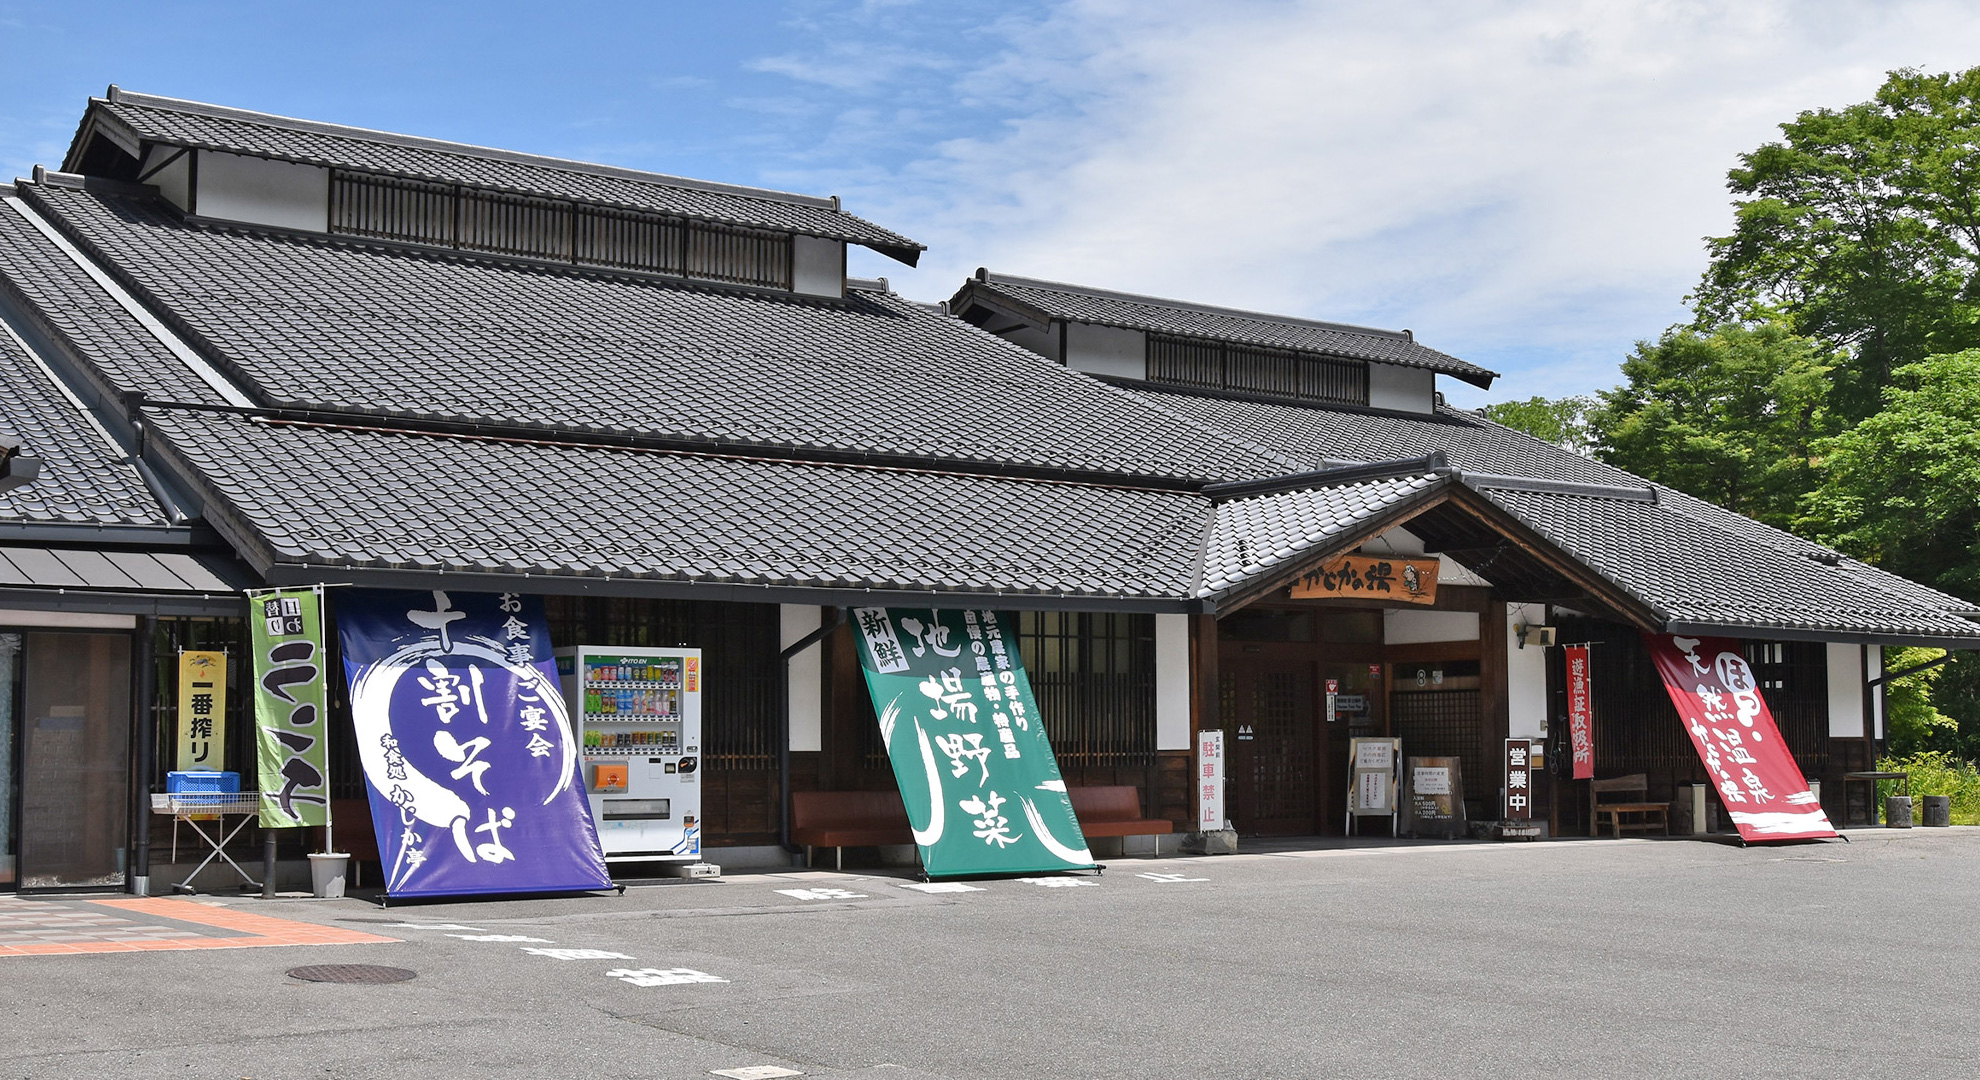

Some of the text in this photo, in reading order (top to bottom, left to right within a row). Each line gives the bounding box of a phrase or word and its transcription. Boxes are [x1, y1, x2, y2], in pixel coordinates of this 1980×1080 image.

[499, 593, 554, 758] お食事 ご宴会
[863, 610, 903, 669] 新鮮
[982, 610, 1028, 732] 地元農家の手作り
[190, 681, 213, 763] 一番搾り
[407, 591, 516, 864] 十割そば
[901, 609, 1023, 850] 地場野菜
[1572, 658, 1590, 764] 遊漁証取扱所
[1673, 636, 1775, 805] 天然温泉
[380, 733, 427, 868] 和食処 かじか亭
[1203, 741, 1215, 823] 駐車禁止
[1509, 747, 1527, 812] 営業中
